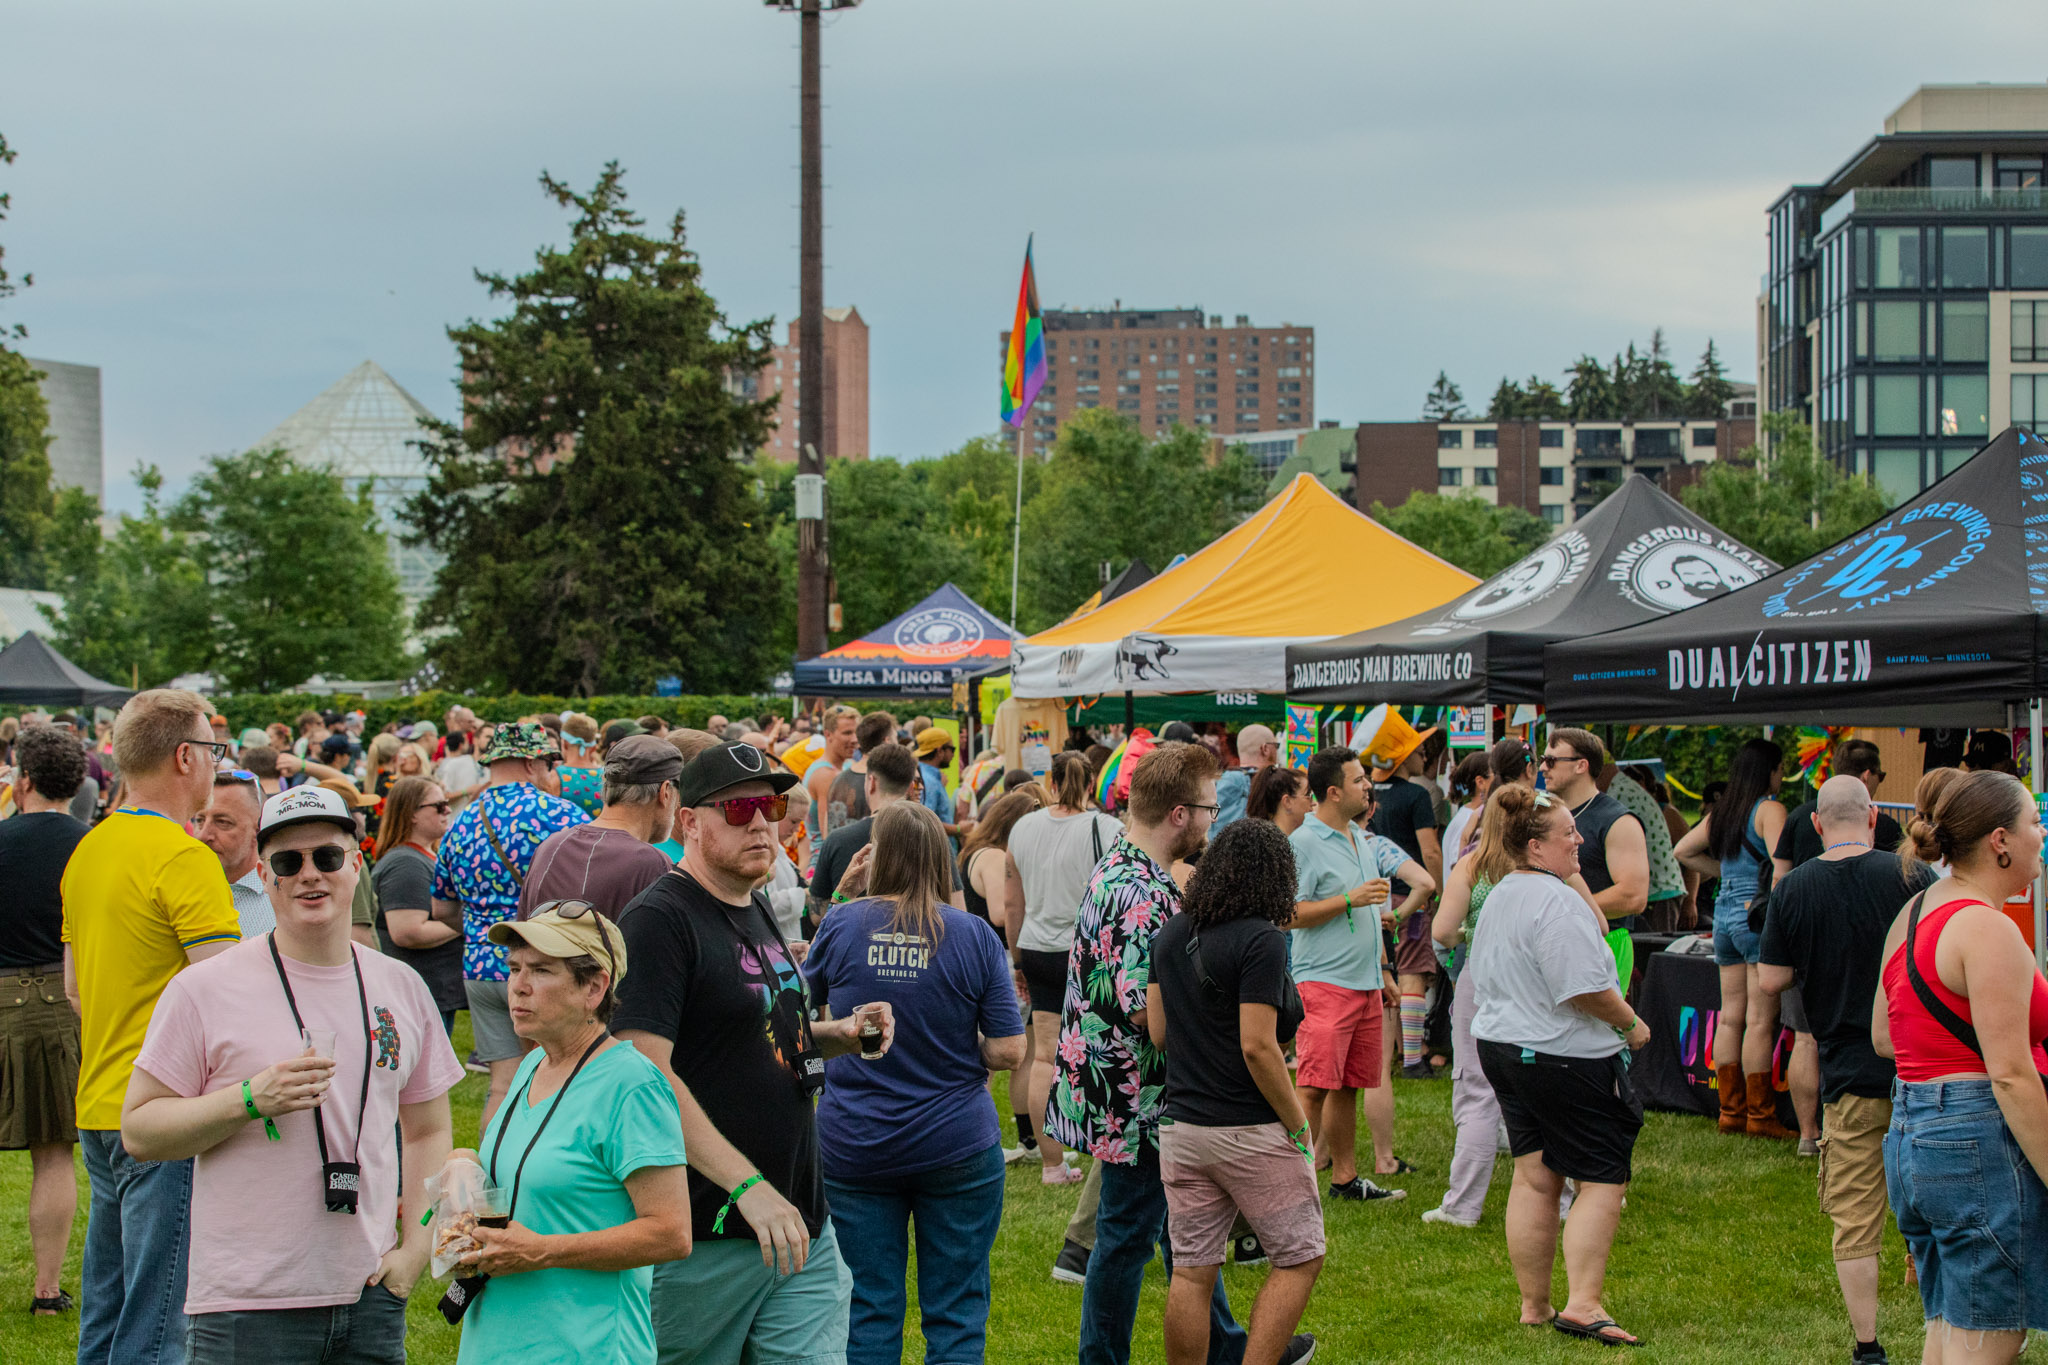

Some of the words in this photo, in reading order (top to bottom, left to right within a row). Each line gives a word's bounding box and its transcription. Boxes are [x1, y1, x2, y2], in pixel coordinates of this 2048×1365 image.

[1900, 502, 1992, 542] BREWING
[1607, 525, 1713, 581] DANGEROUS
[1845, 543, 1986, 613] COMPANY
[1886, 655, 1907, 664] SAINT
[1910, 655, 1930, 663] PAUL
[1946, 653, 1991, 662] MINNESOTA
[827, 668, 876, 685] URSA
[882, 668, 944, 685] MINOR
[1293, 657, 1361, 689] DANGEROUS
[1362, 655, 1390, 683] MAN
[1392, 652, 1451, 682] BREWING
[1454, 652, 1472, 680] CO
[1573, 673, 1589, 681] DUAL
[1590, 671, 1616, 680] CITIZEN
[1616, 669, 1646, 678] BREWING
[1216, 692, 1258, 705] RISE
[296, 801, 327, 810] MOM
[867, 945, 929, 970] CLUTCH
[877, 968, 907, 977] BREWING
